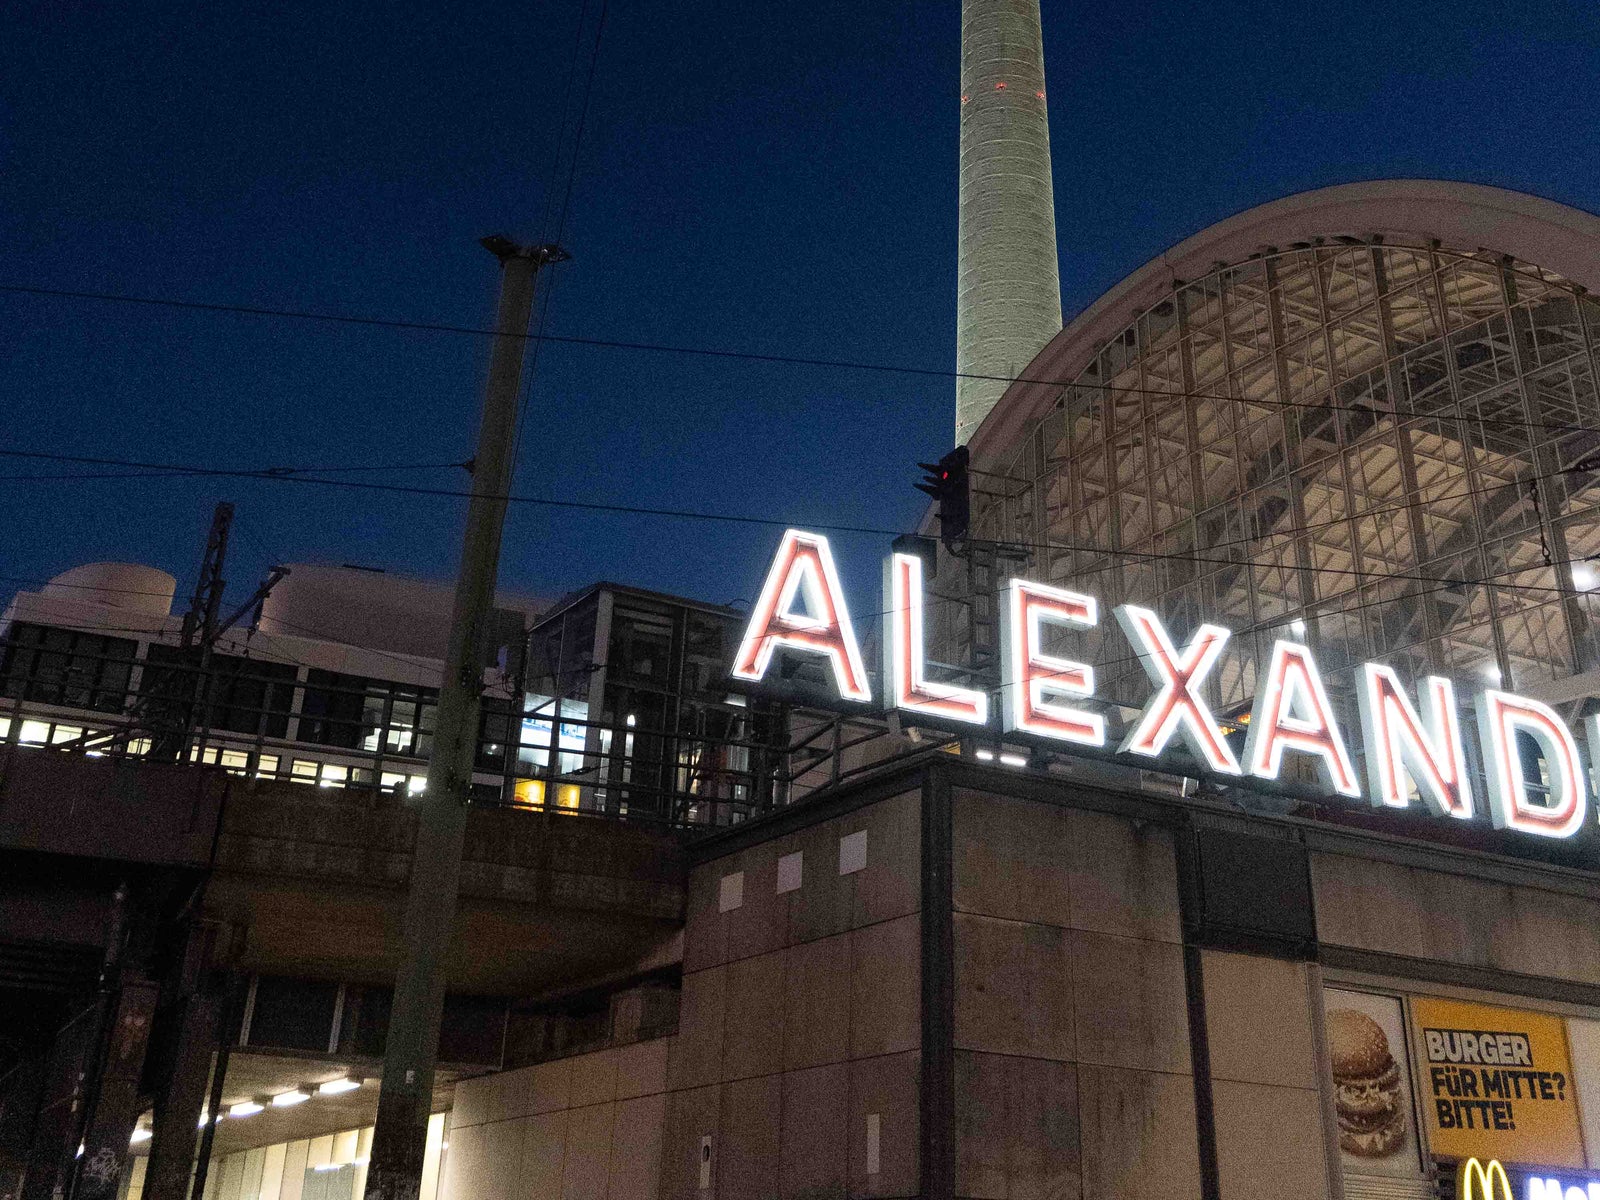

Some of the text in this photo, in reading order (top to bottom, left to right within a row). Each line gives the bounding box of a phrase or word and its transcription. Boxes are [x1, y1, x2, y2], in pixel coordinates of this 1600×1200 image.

[731, 528, 1600, 838] ALEXAND
[1424, 1028, 1533, 1066] BURGER
[1431, 1067, 1566, 1100] FÜR MITTE?
[1435, 1100, 1516, 1130] BITTE!
